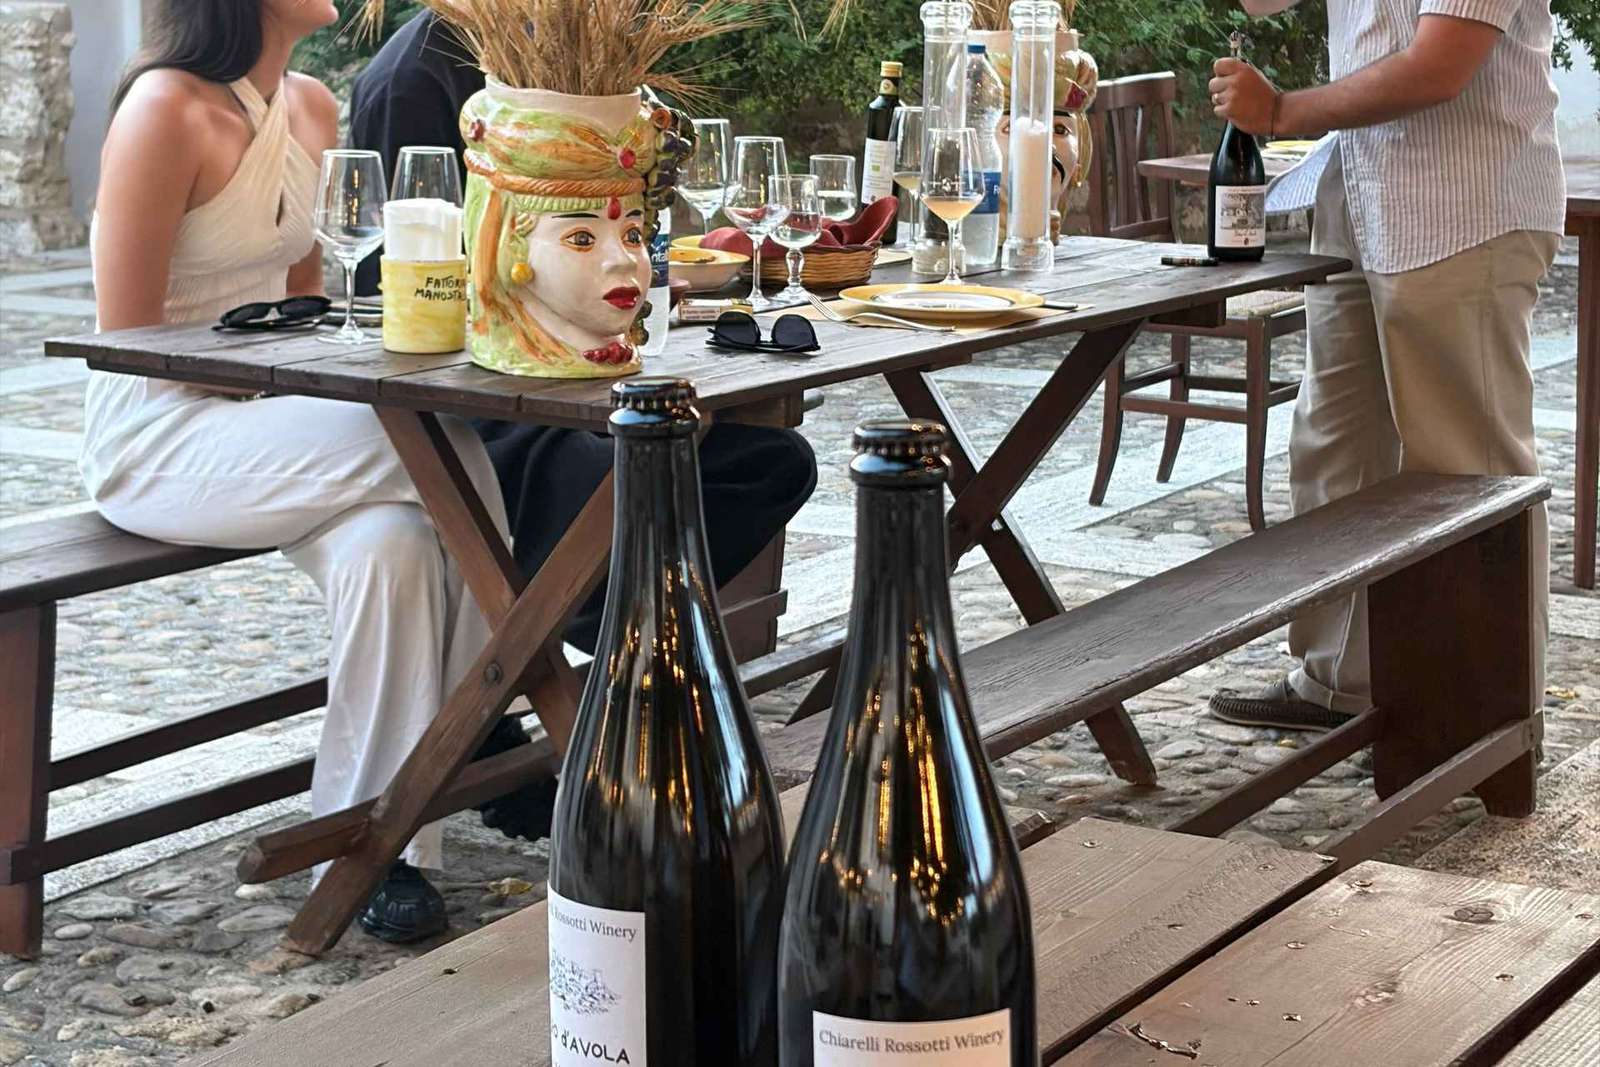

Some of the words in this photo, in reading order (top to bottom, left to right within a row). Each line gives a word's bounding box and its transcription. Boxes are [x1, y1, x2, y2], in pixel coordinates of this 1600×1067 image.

[588, 920, 637, 943] Winery
[561, 1028, 630, 1065] d'AVOLA
[818, 1029, 880, 1053] Chiarelli
[884, 1037, 950, 1054] Rossotti
[953, 1029, 1004, 1049] Winery
